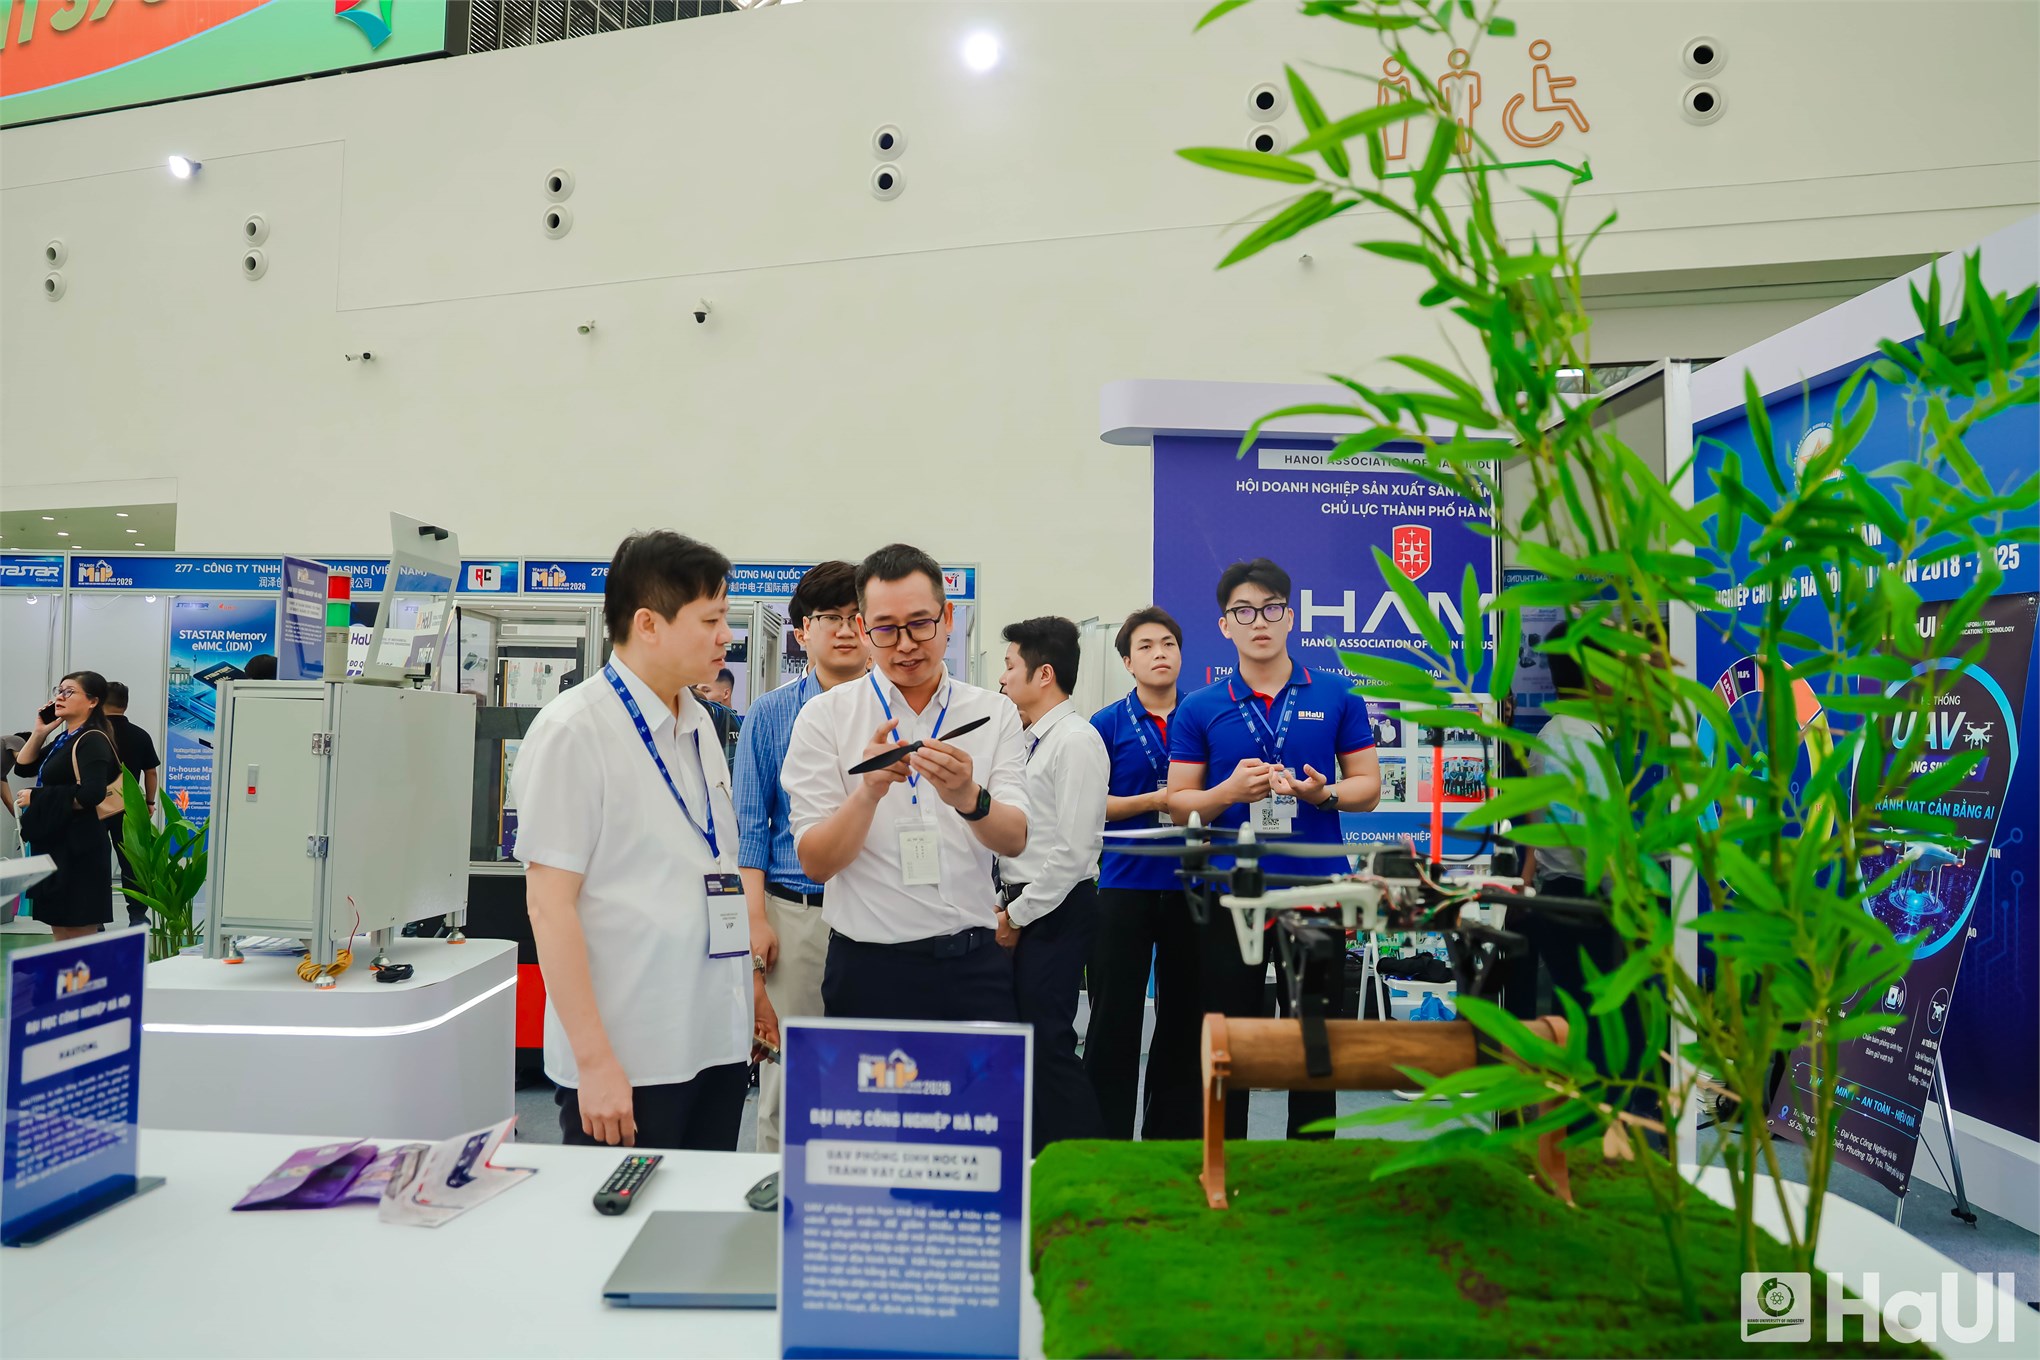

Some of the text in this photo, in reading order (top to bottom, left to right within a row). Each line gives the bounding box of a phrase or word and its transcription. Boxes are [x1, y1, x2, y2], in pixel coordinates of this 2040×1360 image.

[1284, 455, 1323, 465] HANOI
[1236, 478, 1259, 495] HỘI
[1262, 481, 1309, 493] DOANH
[1312, 480, 1359, 499] NGHIỆP
[1362, 480, 1388, 495] SẢN
[1391, 480, 1425, 496] XUẤT
[1321, 500, 1476, 519] CHỦ LỰC THÀNH PHỐ HÀ
[175, 563, 193, 573] 277
[203, 562, 233, 573] CÔNG
[236, 564, 249, 573] TY
[252, 564, 280, 574] TNHH
[760, 570, 775, 581] MẠI
[777, 567, 801, 580] QUỐC
[117, 578, 133, 586] 2026
[1779, 577, 1797, 605] ỰC
[1826, 566, 1841, 598] ỘI
[1921, 554, 1961, 582] 2018
[569, 582, 586, 591] 2026
[728, 582, 799, 593] 越中电子国际商贸
[1300, 589, 1494, 635] HAM
[179, 630, 267, 642] STASTAR Memory
[350, 633, 372, 646] HaU
[192, 641, 253, 652] eMMC (IDM)
[1301, 638, 1428, 649] HANOI ASSOCIATION OF
[1933, 692, 1961, 706] THỐNG
[1305, 711, 1325, 719] HaUI
[1891, 711, 1967, 750] UAV
[168, 765, 201, 773] In-house
[1875, 795, 1904, 811] RÁNH
[1928, 797, 1951, 817] CẢN
[1952, 799, 1982, 819] BẰNG
[1984, 805, 1995, 820] AI
[1361, 832, 1395, 841] DOANH
[1397, 831, 1432, 843] NGHIỆP
[1967, 926, 1977, 939] ẠO
[1861, 1096, 1873, 1109] AN
[1874, 1099, 1892, 1116] TOÀN
[1840, 1128, 1850, 1140] Đại
[1850, 1132, 1860, 1144] học
[1859, 1136, 1873, 1151] Công
[1845, 1145, 1866, 1161] Phường
